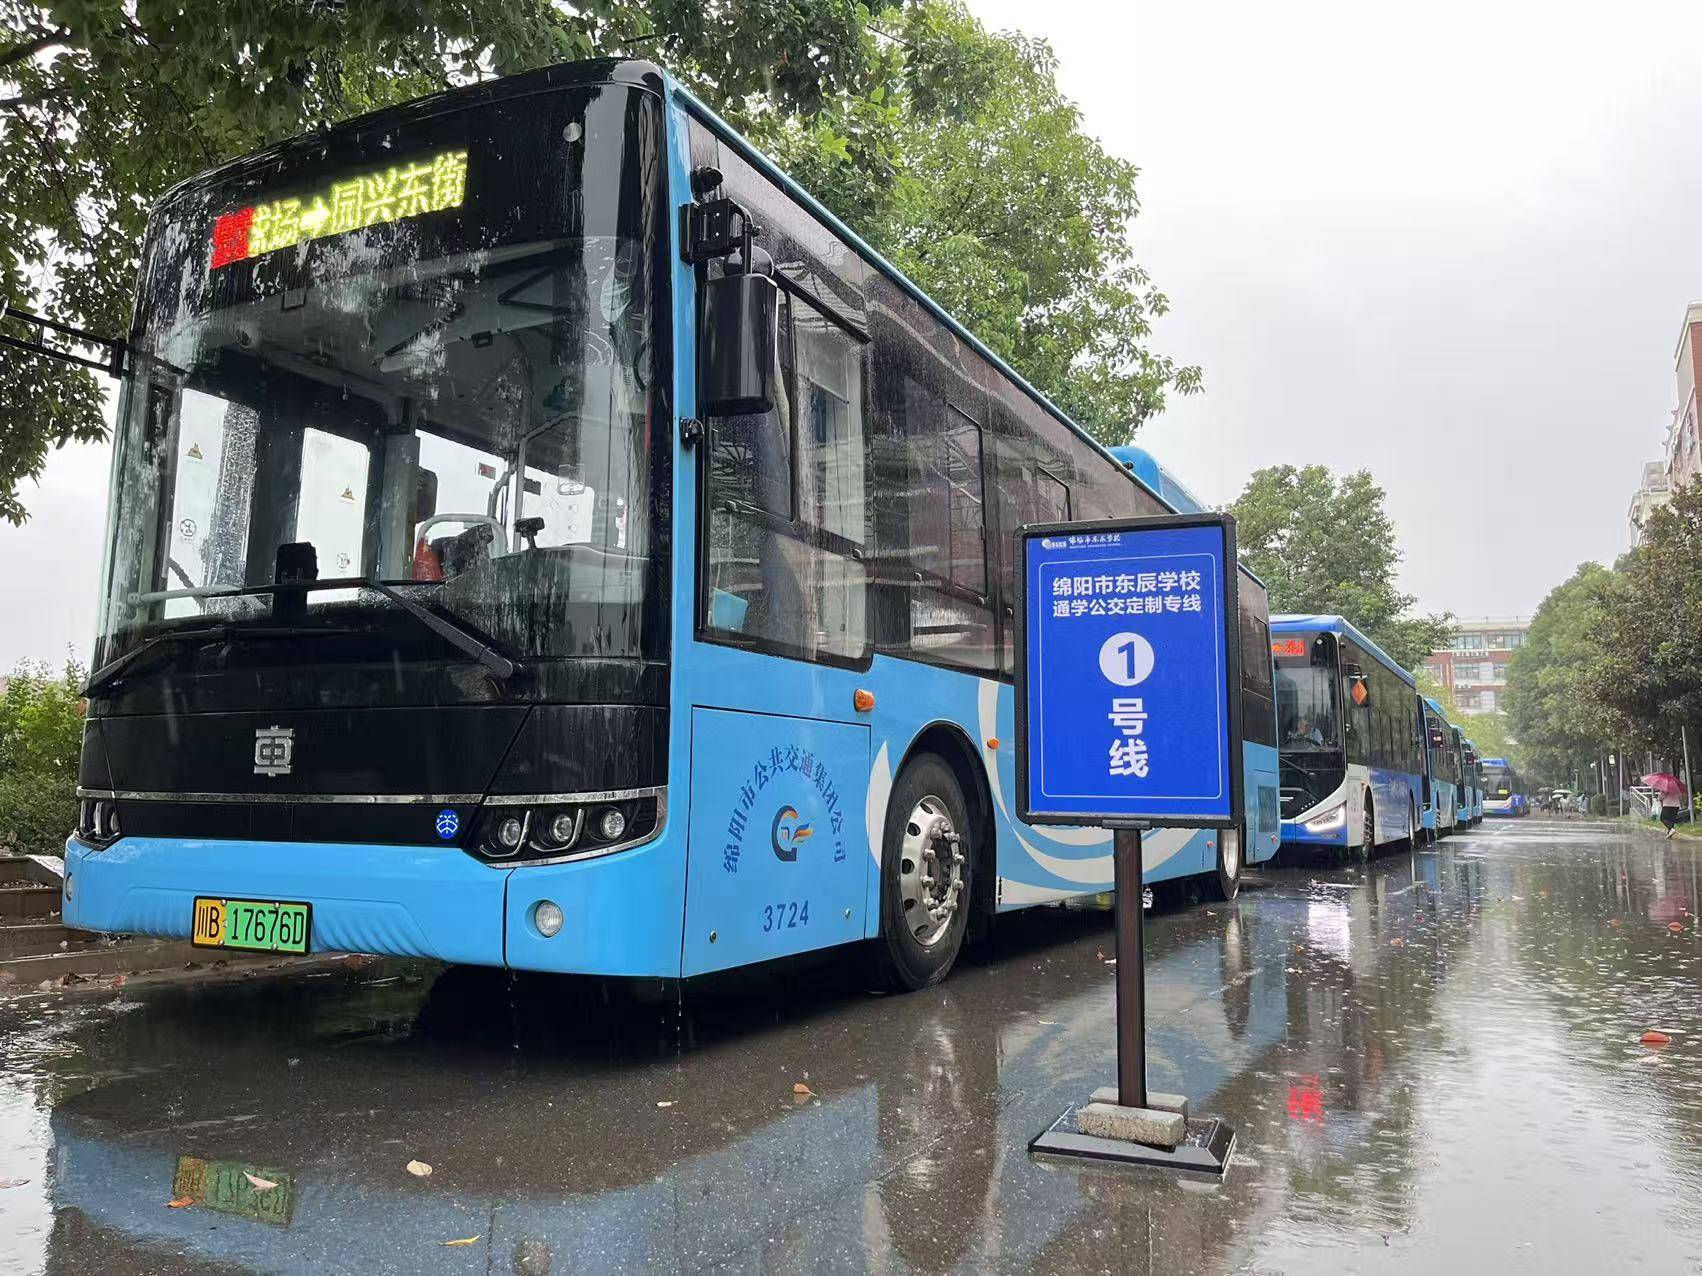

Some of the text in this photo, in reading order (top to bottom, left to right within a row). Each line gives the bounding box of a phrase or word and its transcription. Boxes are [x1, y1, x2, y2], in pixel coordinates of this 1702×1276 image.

[1052, 570, 1201, 597] 绵阳市东辰学校
[1052, 594, 1202, 618] 通学公交定制专线
[723, 744, 846, 874] 绵阳市公共交通集团公司
[763, 900, 809, 933] 3724
